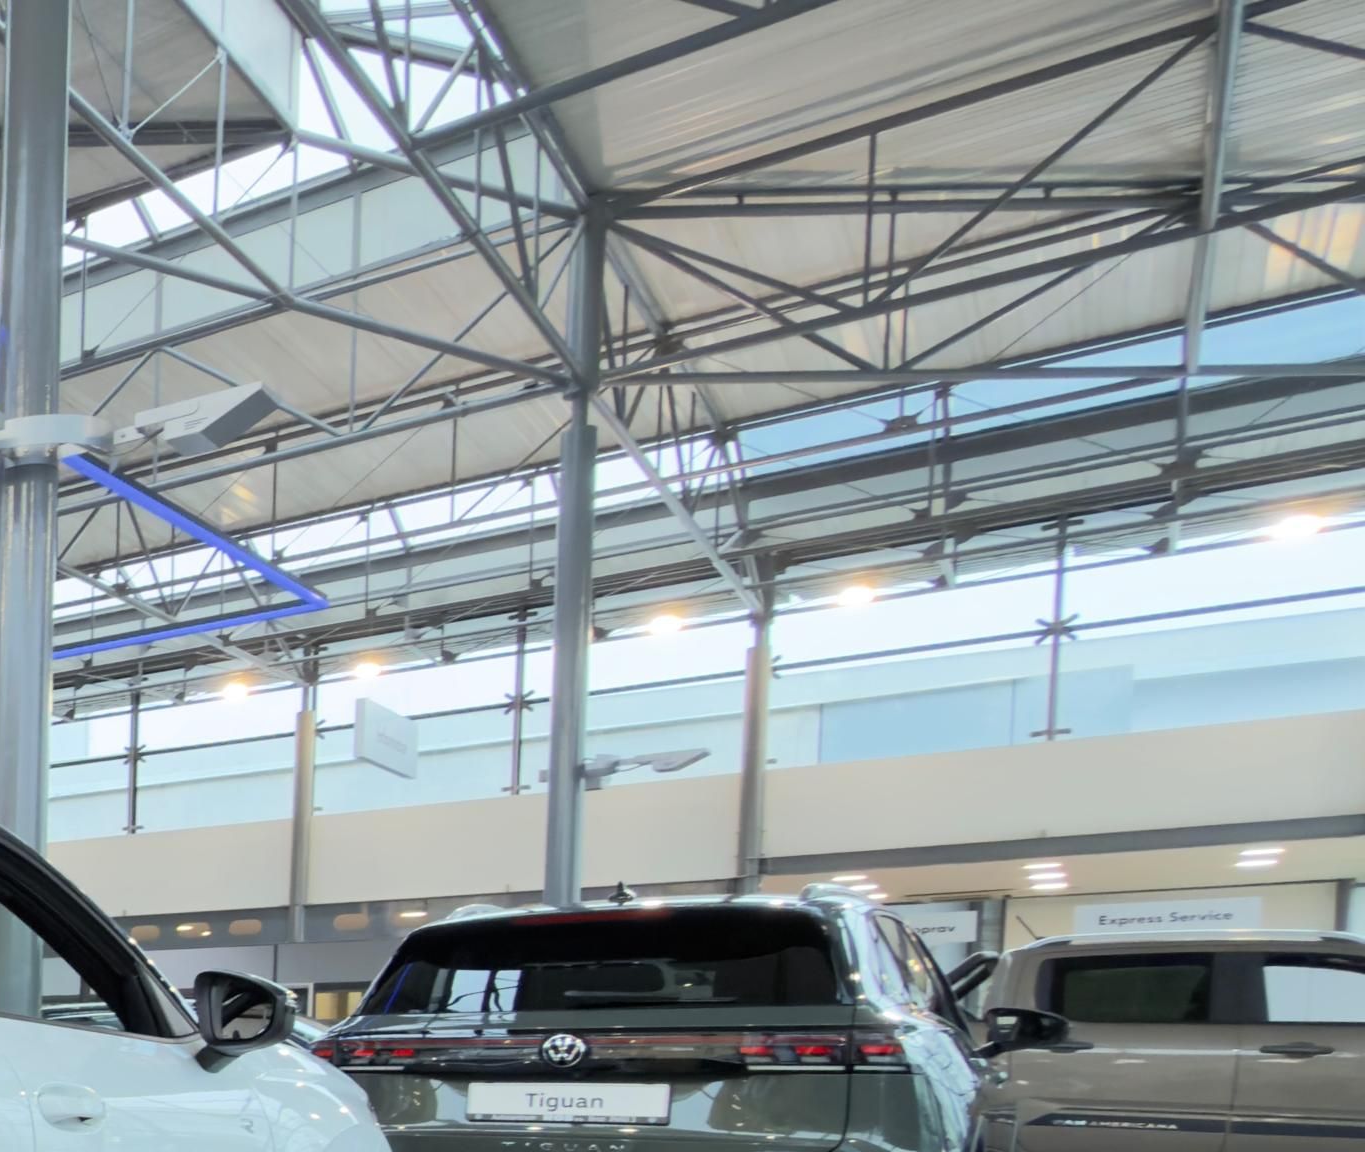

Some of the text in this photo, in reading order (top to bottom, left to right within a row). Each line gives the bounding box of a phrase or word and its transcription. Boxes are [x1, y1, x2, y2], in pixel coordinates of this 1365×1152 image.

[1098, 910, 1234, 927] Express Service
[525, 1092, 604, 1111] Tiguan
[501, 1140, 626, 1152] TIGUAN
